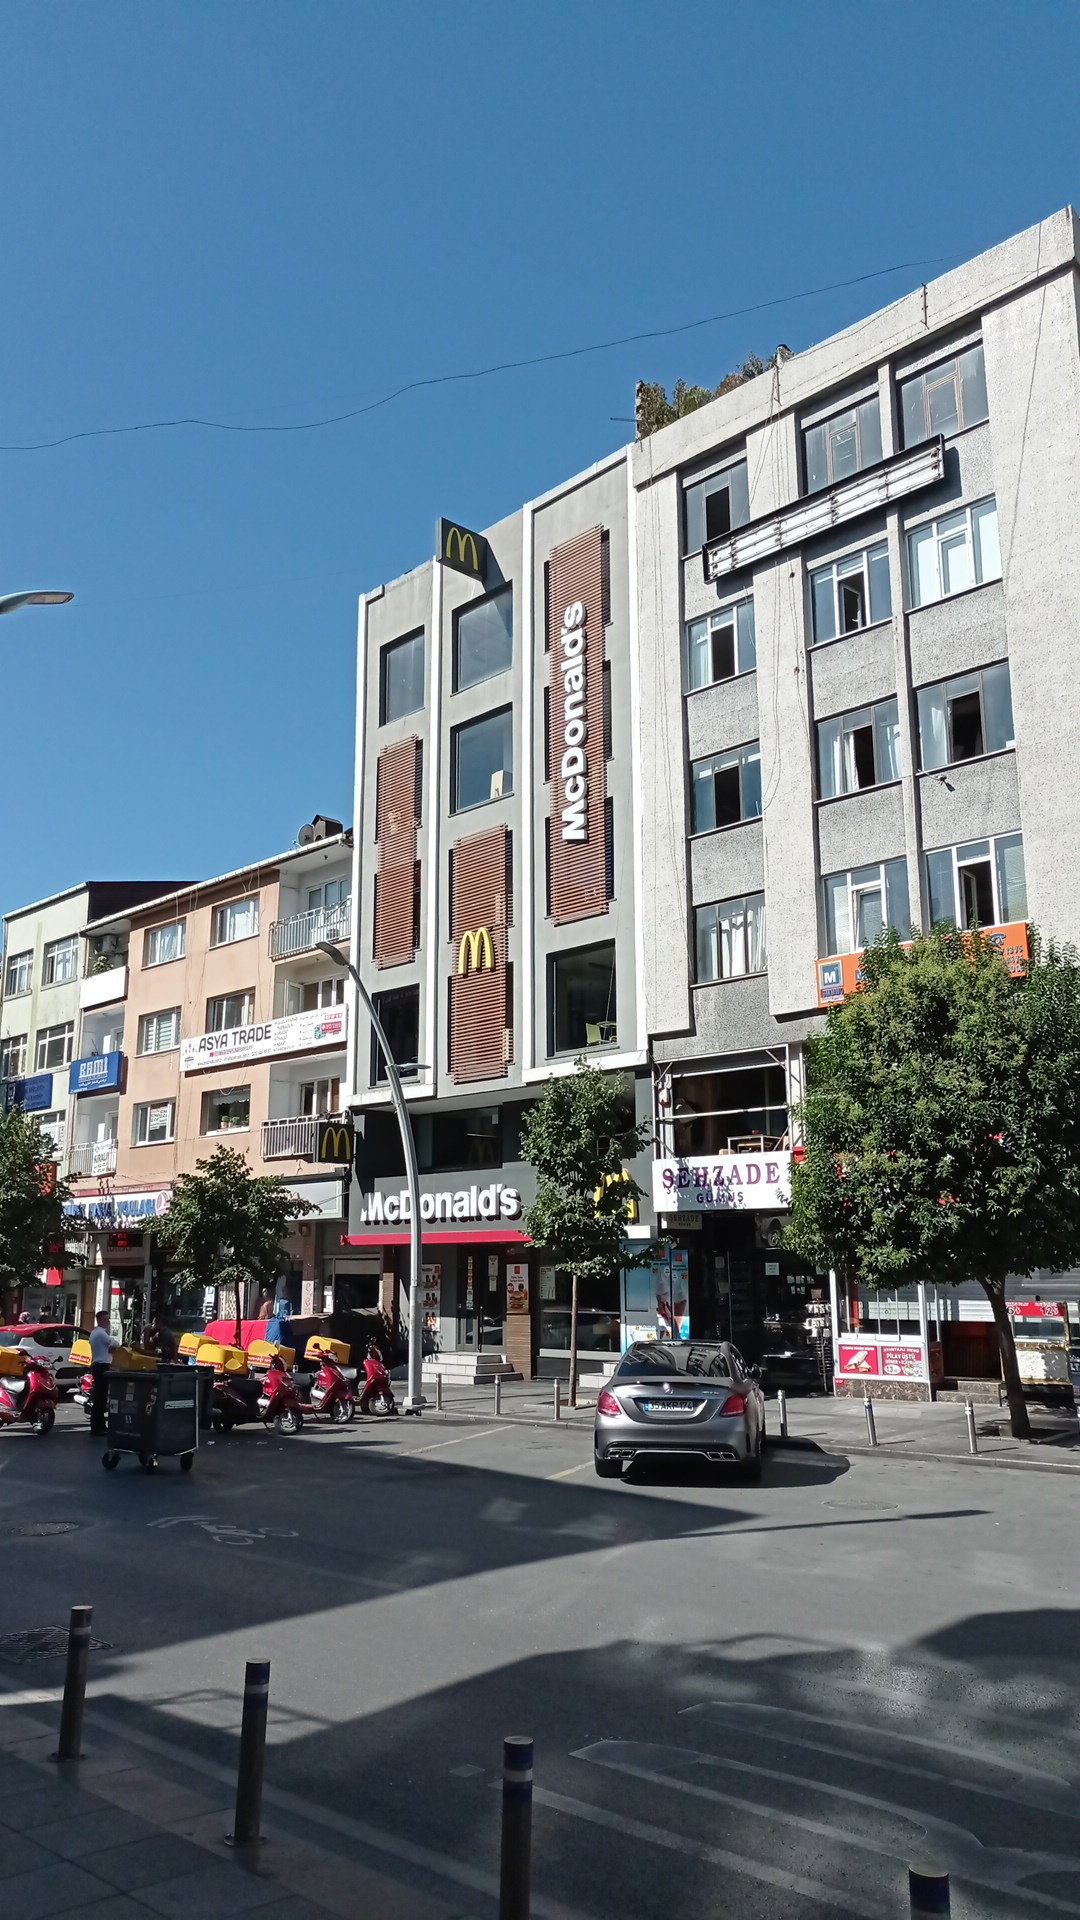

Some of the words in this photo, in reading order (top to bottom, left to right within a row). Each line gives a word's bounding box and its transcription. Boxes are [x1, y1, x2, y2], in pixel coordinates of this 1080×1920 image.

[561, 600, 587, 840] McDonald's
[198, 1033, 228, 1053] ASYA
[232, 1024, 272, 1046] TRADE
[662, 1162, 780, 1194] ŞEHZADE
[360, 1183, 520, 1222] McDonald's
